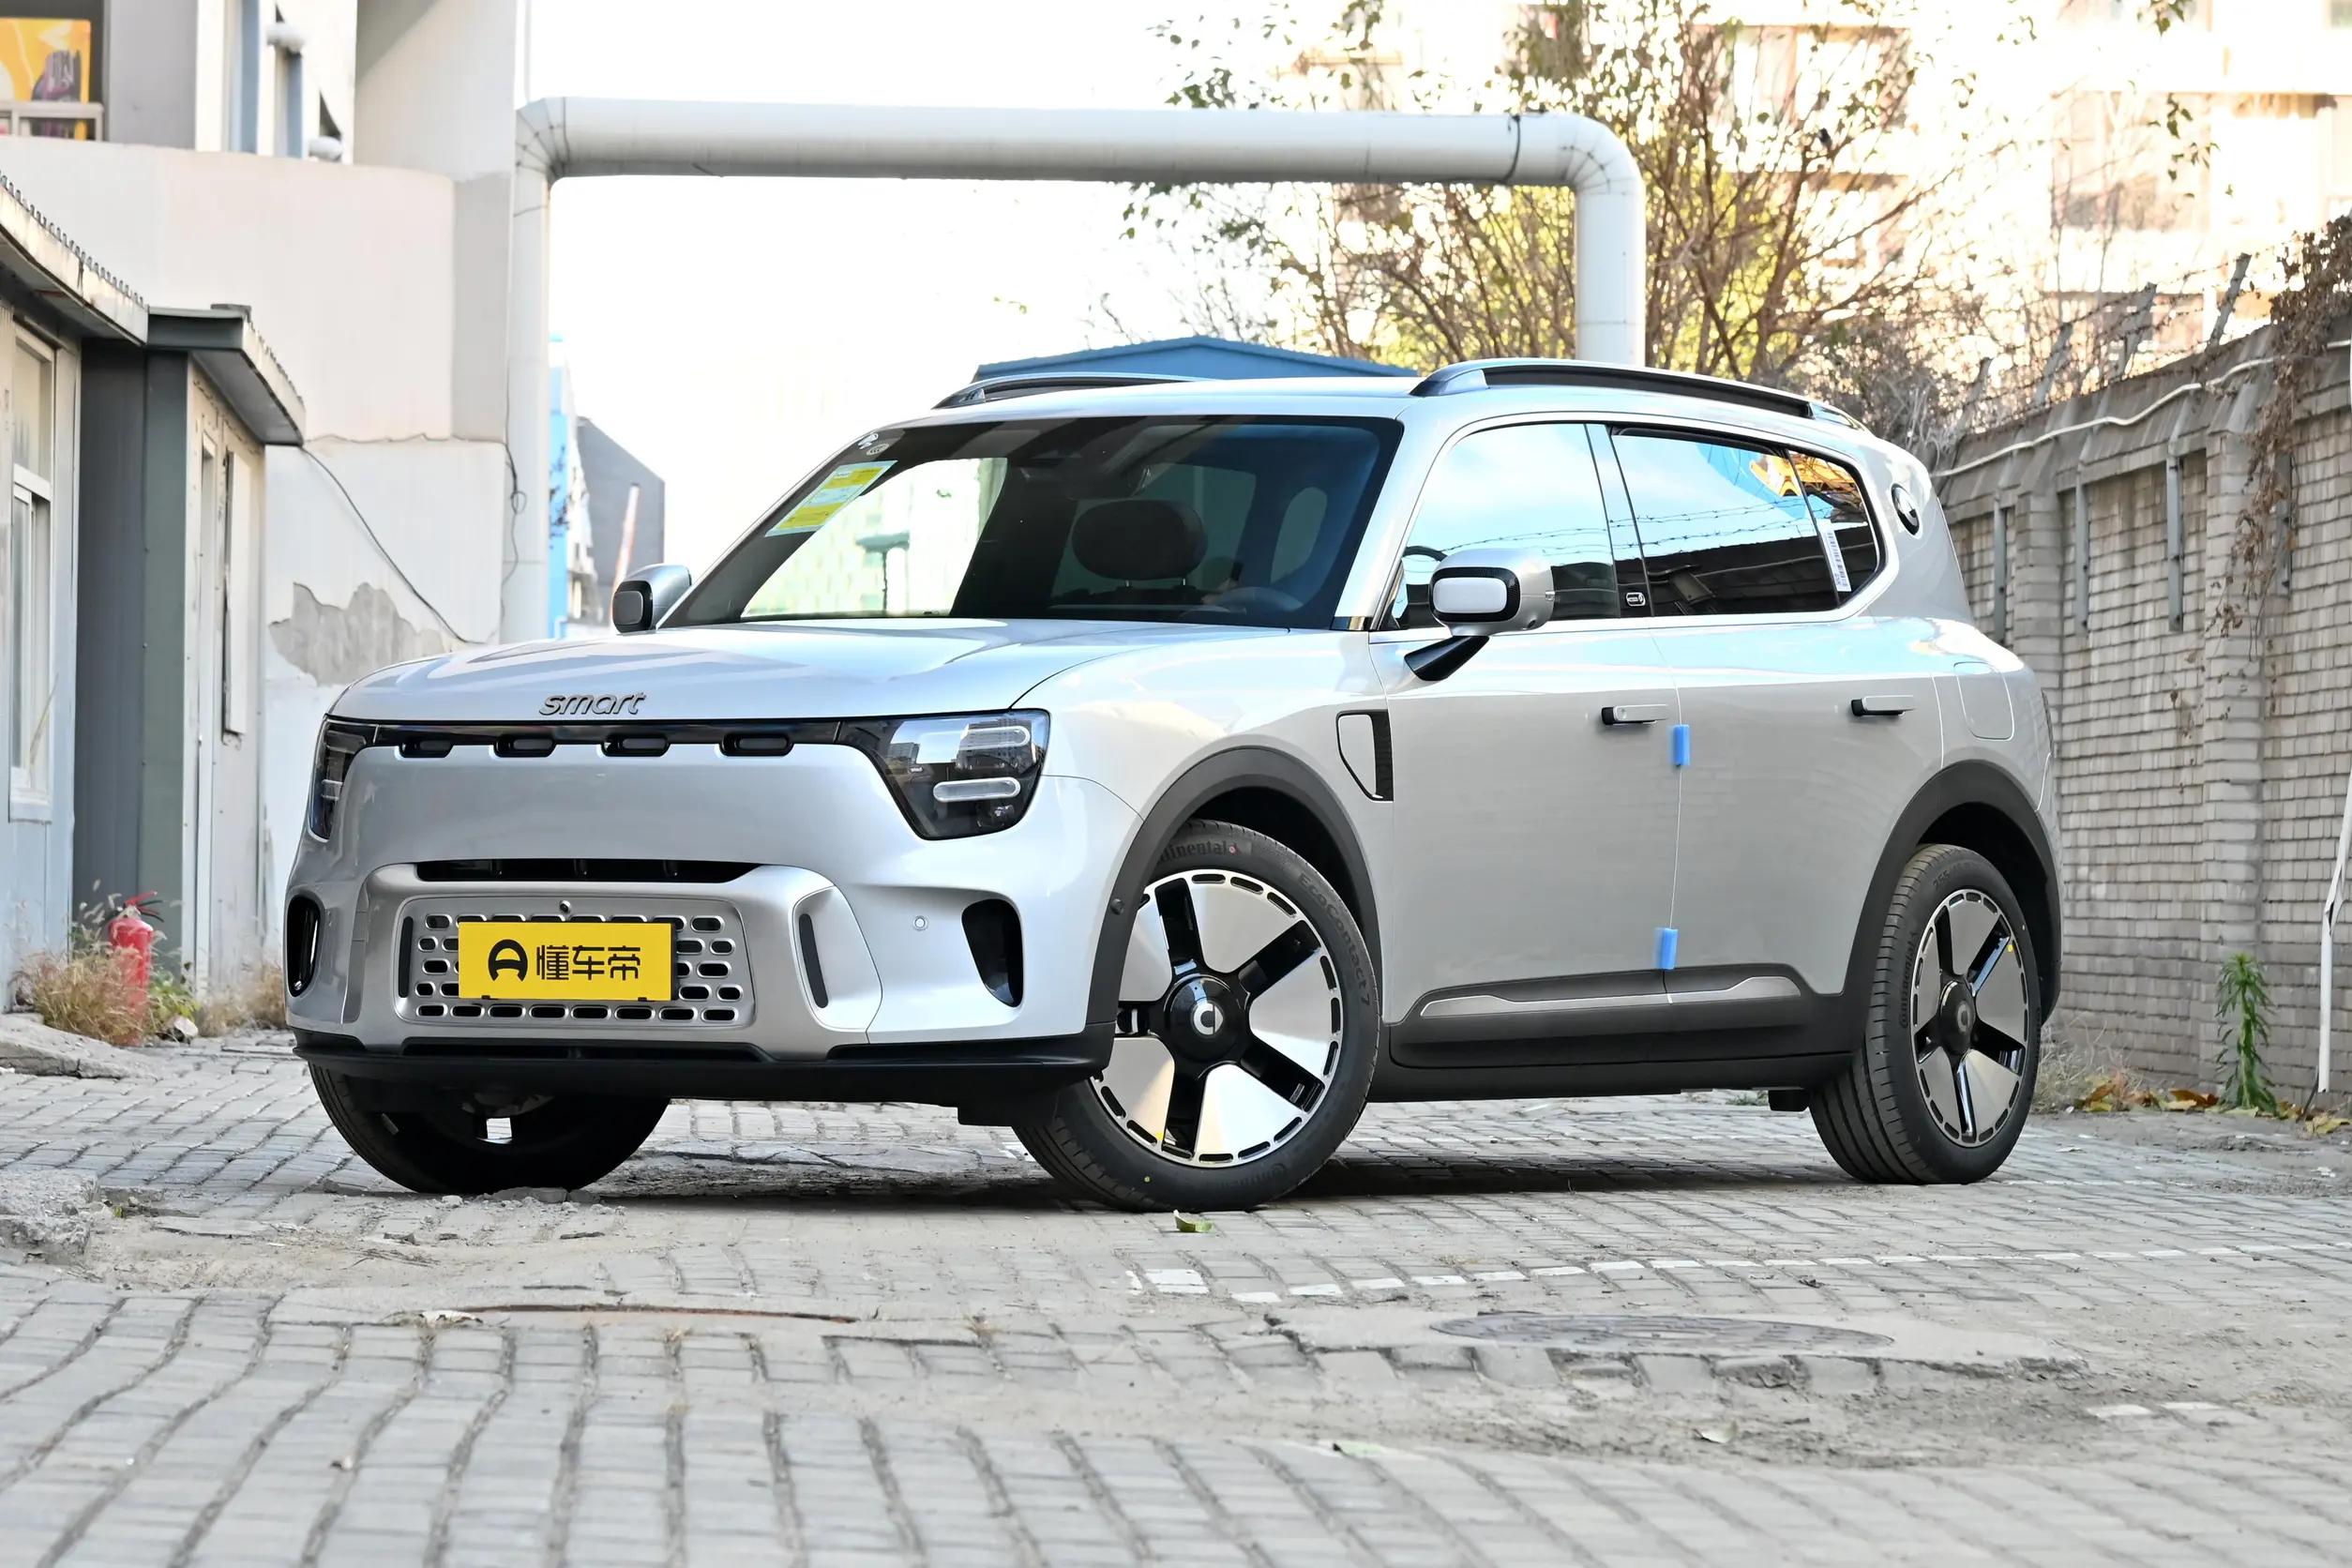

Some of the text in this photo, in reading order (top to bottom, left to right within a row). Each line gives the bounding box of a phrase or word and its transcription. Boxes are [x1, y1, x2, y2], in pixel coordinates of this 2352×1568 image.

[539, 692, 647, 716] smart
[1160, 840, 1228, 863] tinental
[1299, 872, 1367, 989] EcoContact
[536, 944, 641, 981] 懂车帝
